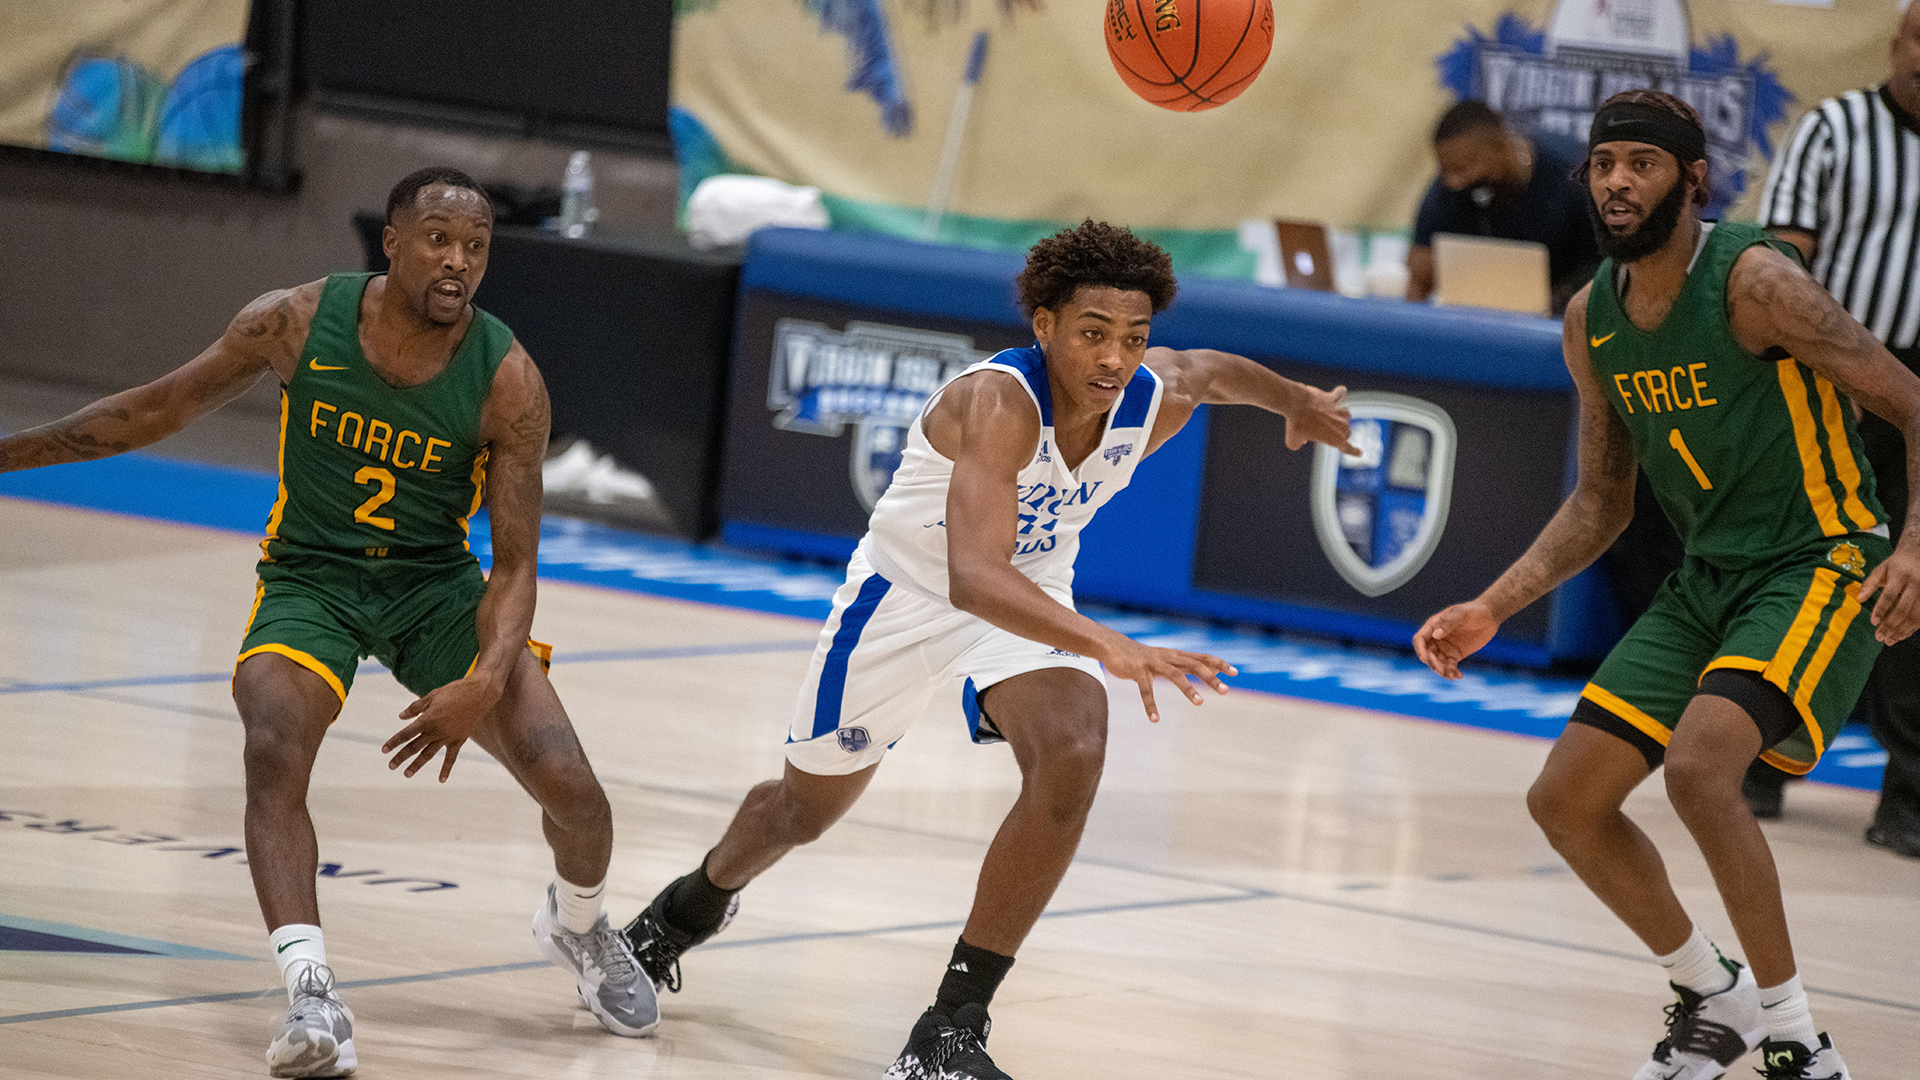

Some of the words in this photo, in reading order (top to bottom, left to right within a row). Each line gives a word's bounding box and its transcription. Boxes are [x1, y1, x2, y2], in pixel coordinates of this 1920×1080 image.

[1613, 362, 1718, 414] FORCE
[310, 400, 452, 472] FORCE
[1668, 428, 1714, 491] 1
[354, 465, 396, 531] 2
